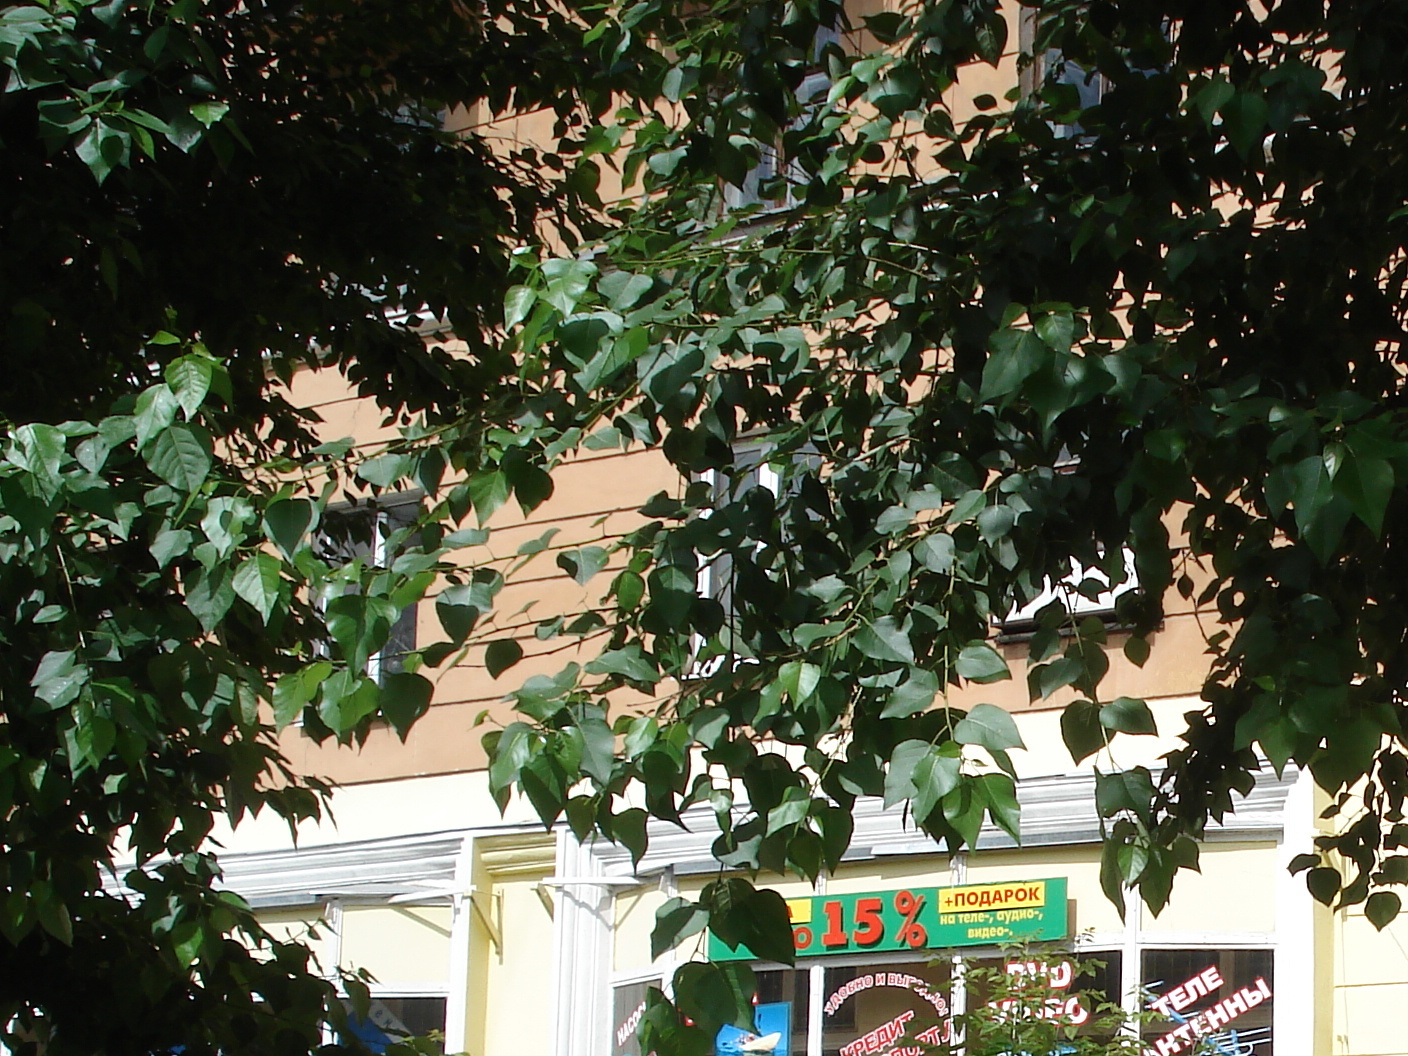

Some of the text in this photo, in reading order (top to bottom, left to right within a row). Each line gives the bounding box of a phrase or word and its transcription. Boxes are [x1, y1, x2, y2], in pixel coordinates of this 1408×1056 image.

[822, 891, 926, 948] 15%
[940, 914, 956, 925] на
[944, 886, 1041, 908] +ПОДАРОК
[824, 974, 874, 1017] УДОБНО
[875, 972, 886, 986] И
[1151, 965, 1225, 1018] ТЕЛЕ
